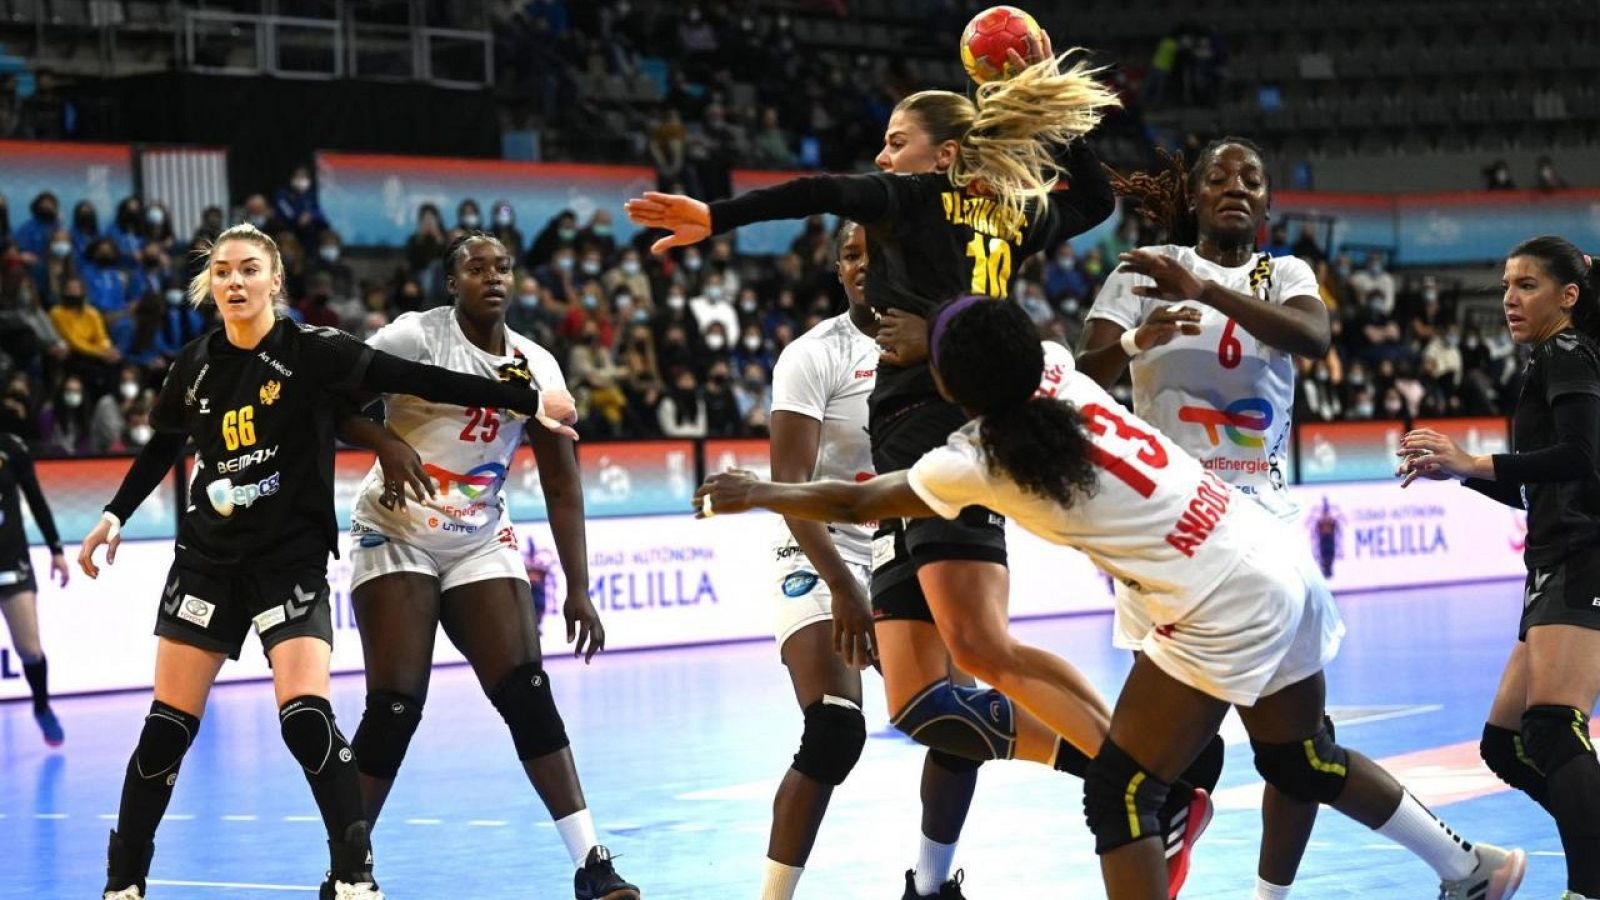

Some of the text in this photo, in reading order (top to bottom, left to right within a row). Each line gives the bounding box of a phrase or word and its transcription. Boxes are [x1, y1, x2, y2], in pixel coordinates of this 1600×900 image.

[966, 232, 1011, 298] 10
[1218, 317, 1242, 369] 6
[222, 405, 256, 450] 66
[459, 407, 499, 443] 25
[217, 445, 279, 474] BEMAX
[1082, 404, 1168, 498] 13
[232, 471, 280, 508] epcg
[1355, 523, 1449, 560] MELILLA
